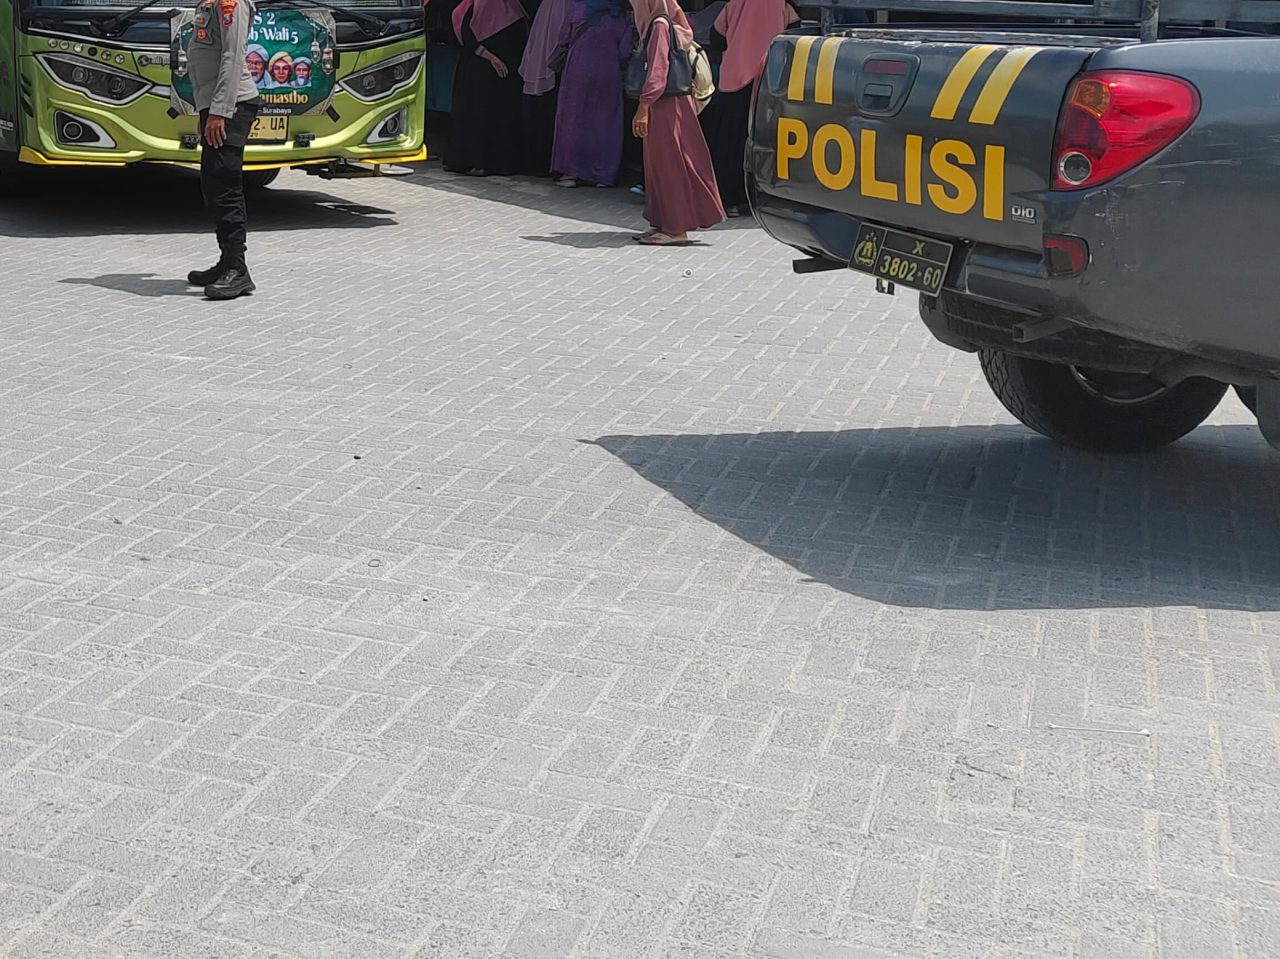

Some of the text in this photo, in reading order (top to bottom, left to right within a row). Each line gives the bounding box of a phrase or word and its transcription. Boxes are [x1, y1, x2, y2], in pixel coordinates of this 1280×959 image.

[259, 27, 289, 41] Wali
[290, 31, 299, 44] 5
[270, 117, 285, 130] UA
[776, 117, 1005, 221] POLISI
[912, 241, 925, 256] X
